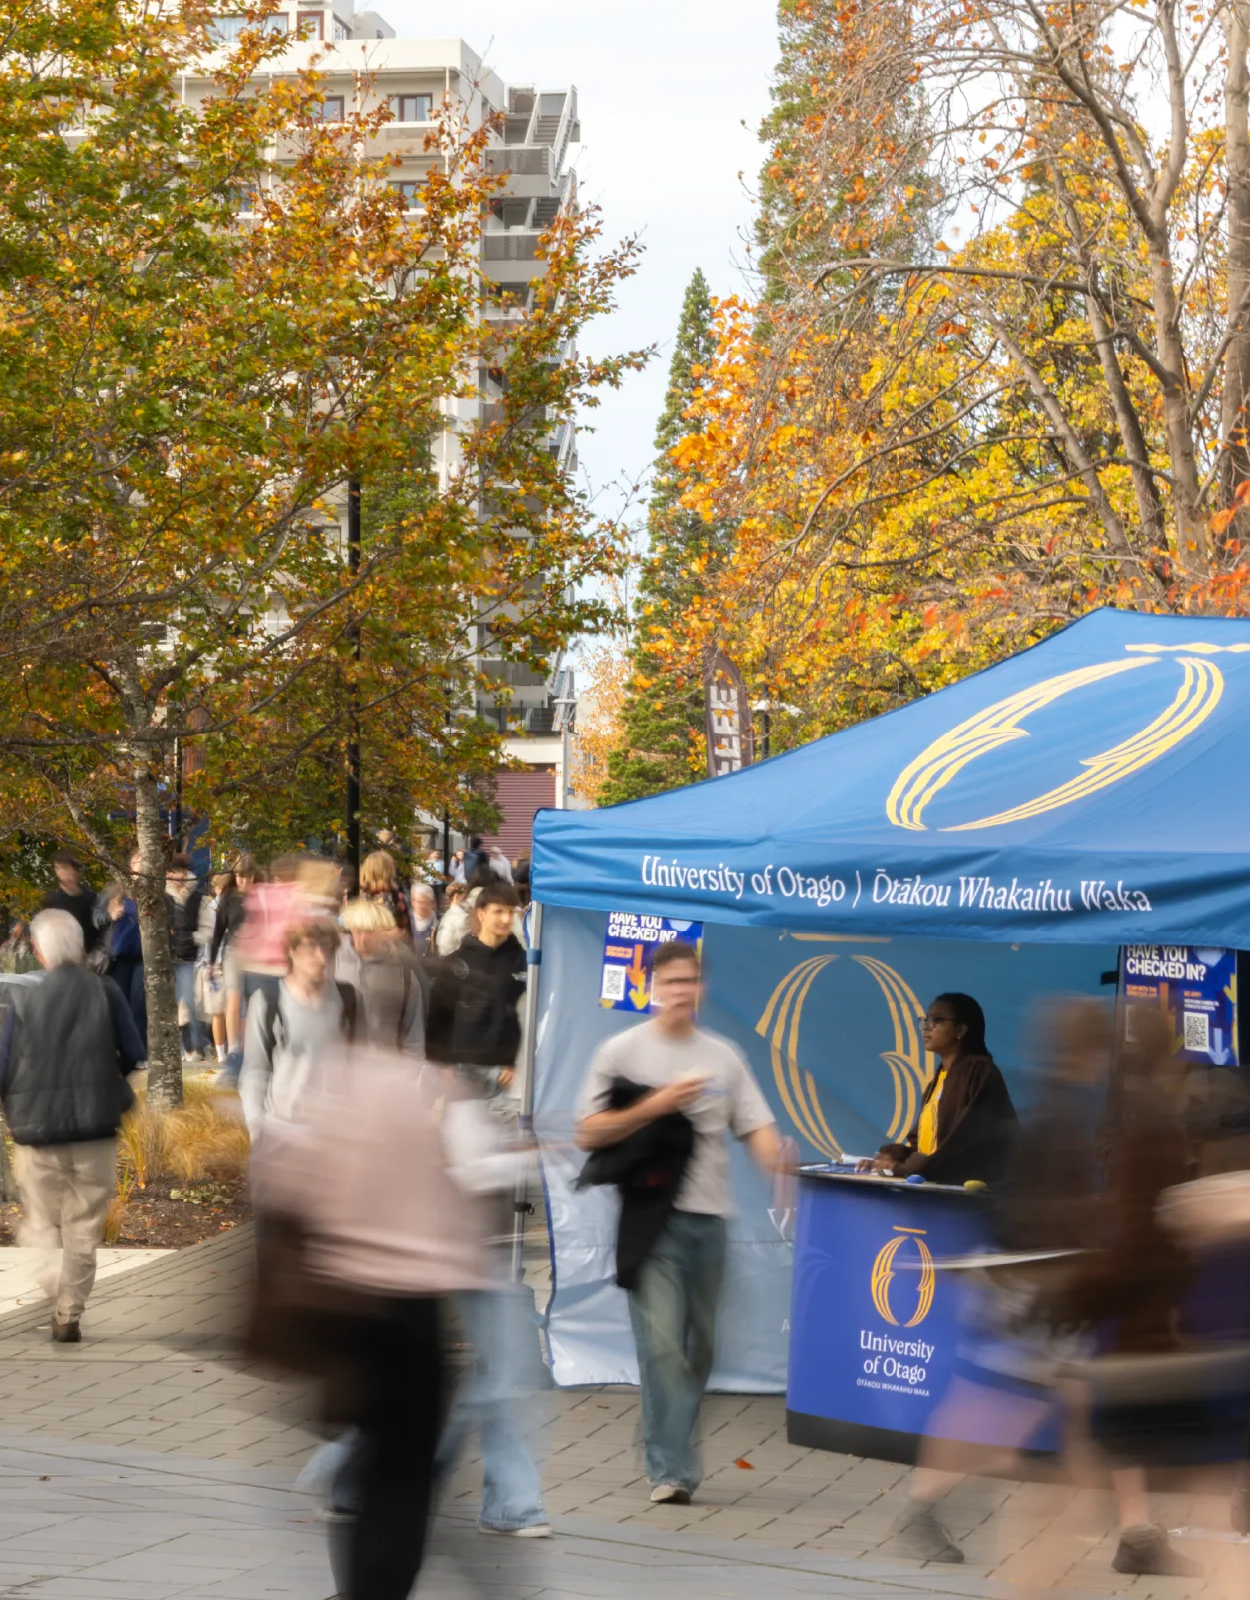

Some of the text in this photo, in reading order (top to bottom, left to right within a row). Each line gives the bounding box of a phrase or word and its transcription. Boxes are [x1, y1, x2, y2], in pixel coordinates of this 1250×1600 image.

[641, 855, 745, 900] University
[751, 864, 774, 895] of
[777, 866, 846, 907] Otago
[872, 868, 952, 907] Ōtākou
[958, 876, 1074, 911] Whakaihu
[1080, 879, 1153, 911] Waka
[609, 912, 662, 929] HAVE YOU
[608, 924, 677, 942] CHECKED IN?
[1127, 945, 1187, 963] HAVE YOU
[1126, 958, 1207, 981] CHECKED IN?
[860, 1330, 934, 1363] University
[863, 1355, 926, 1385] of Otago
